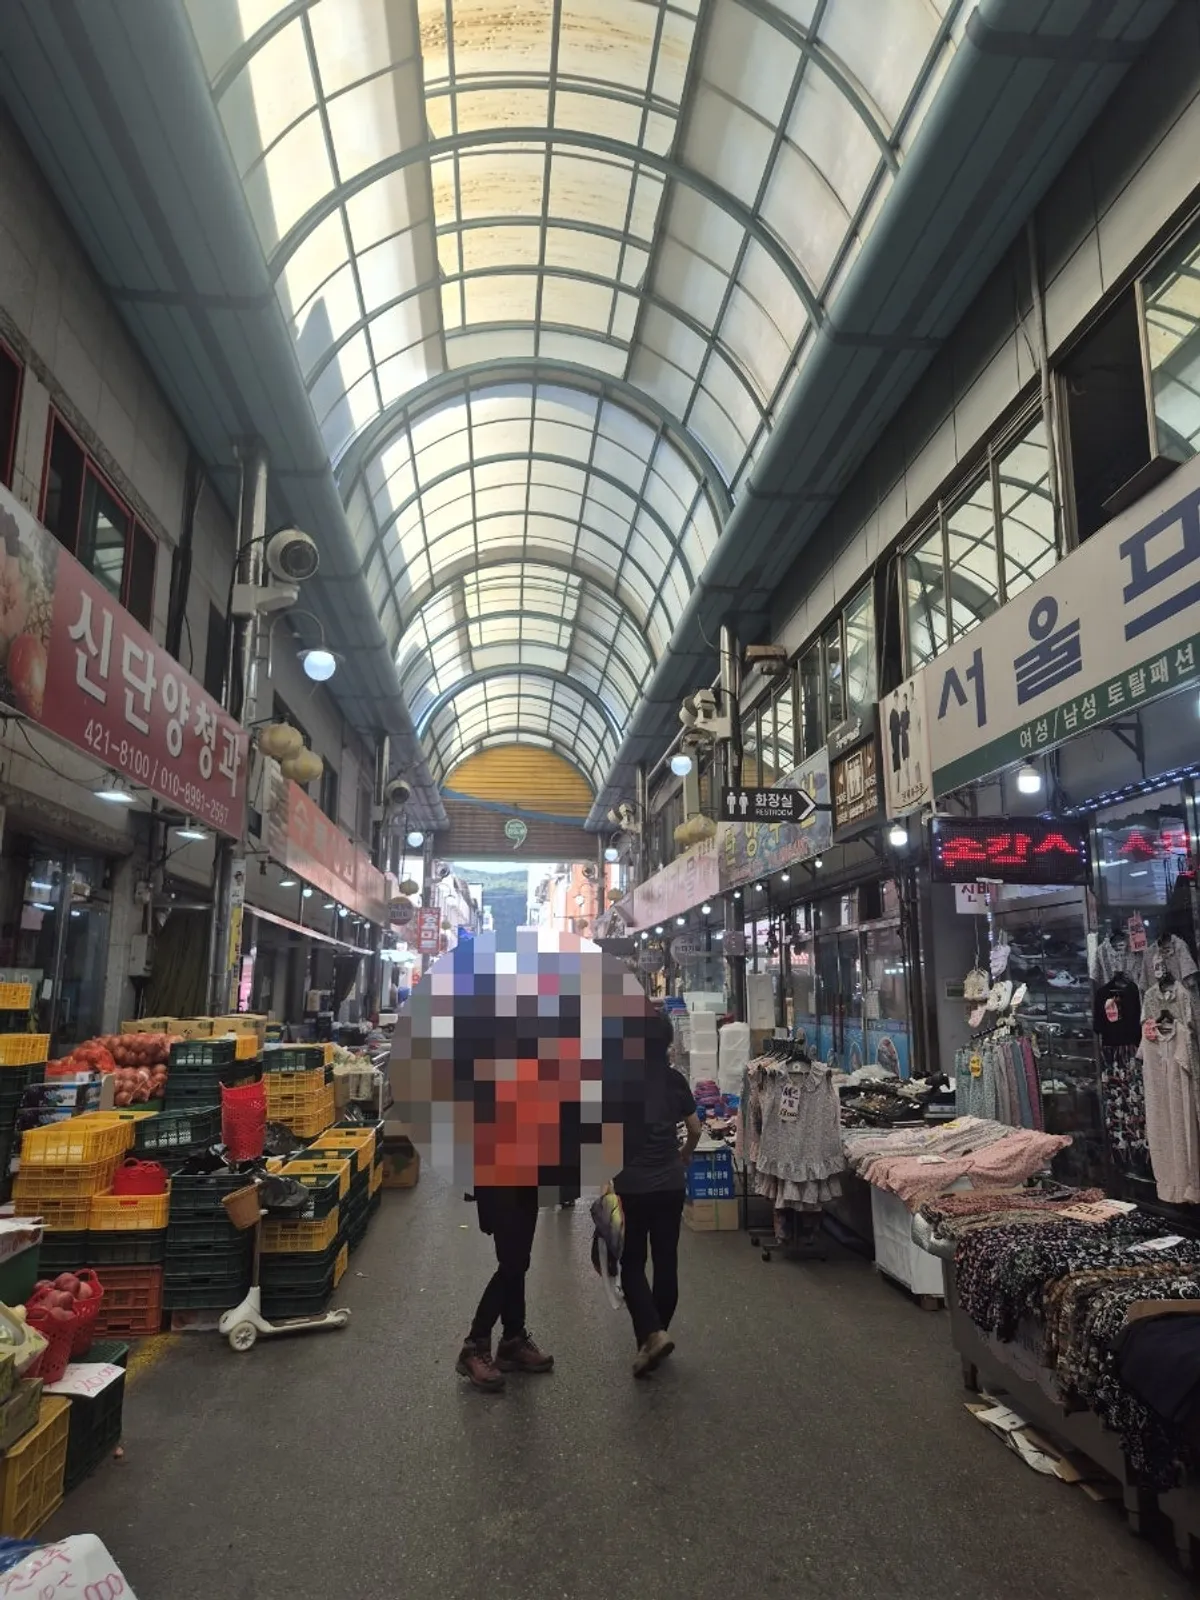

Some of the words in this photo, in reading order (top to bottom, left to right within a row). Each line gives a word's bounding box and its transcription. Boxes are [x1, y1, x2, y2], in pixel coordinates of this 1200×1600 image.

[67, 589, 242, 798] 신단양청과
[1019, 693, 1098, 749] 여성/남성
[84, 719, 150, 779] 421-8100
[755, 792, 794, 808] 화장실
[755, 808, 794, 817] RESTROOM
